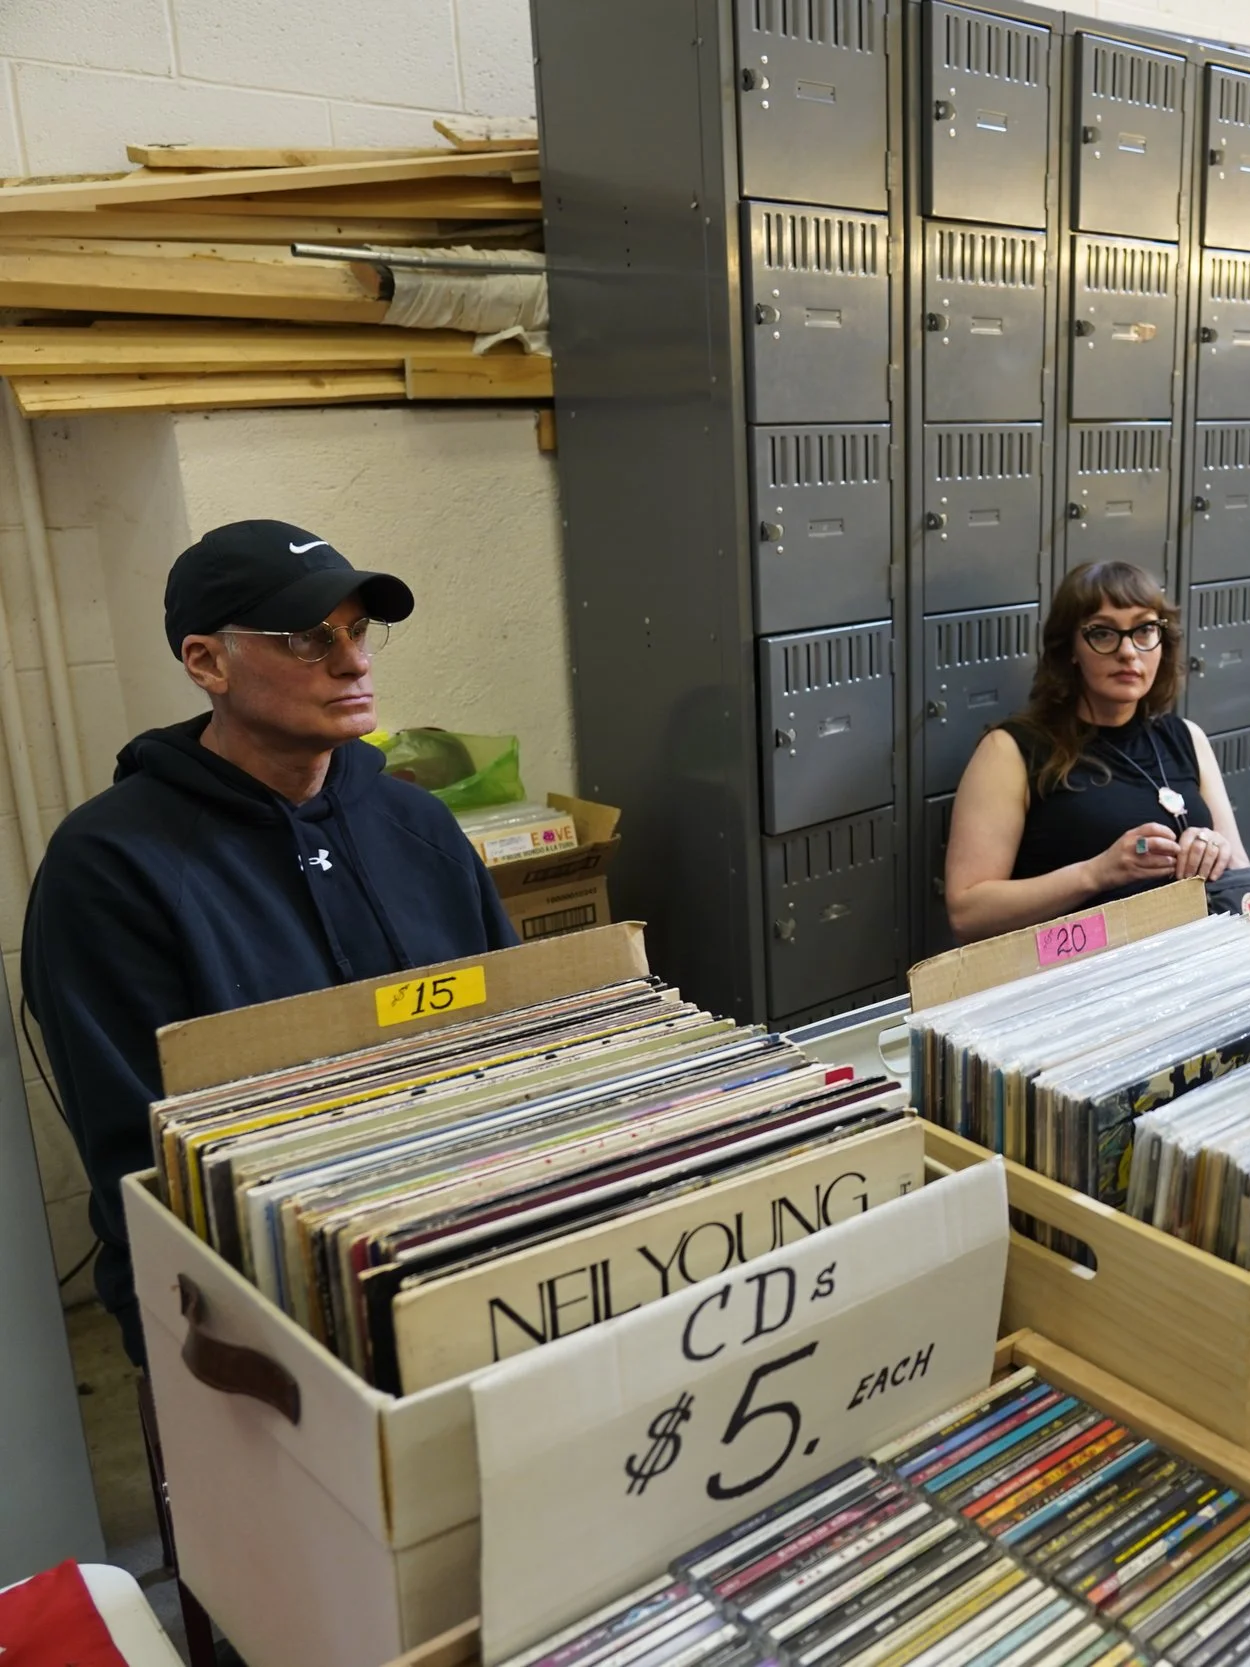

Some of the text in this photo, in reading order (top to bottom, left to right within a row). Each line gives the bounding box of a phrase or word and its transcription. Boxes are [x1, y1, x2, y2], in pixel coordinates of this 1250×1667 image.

[489, 1171, 869, 1363] NEIL YOUNG
[682, 1261, 836, 1362] CDs
[847, 1343, 934, 1410] EACH
